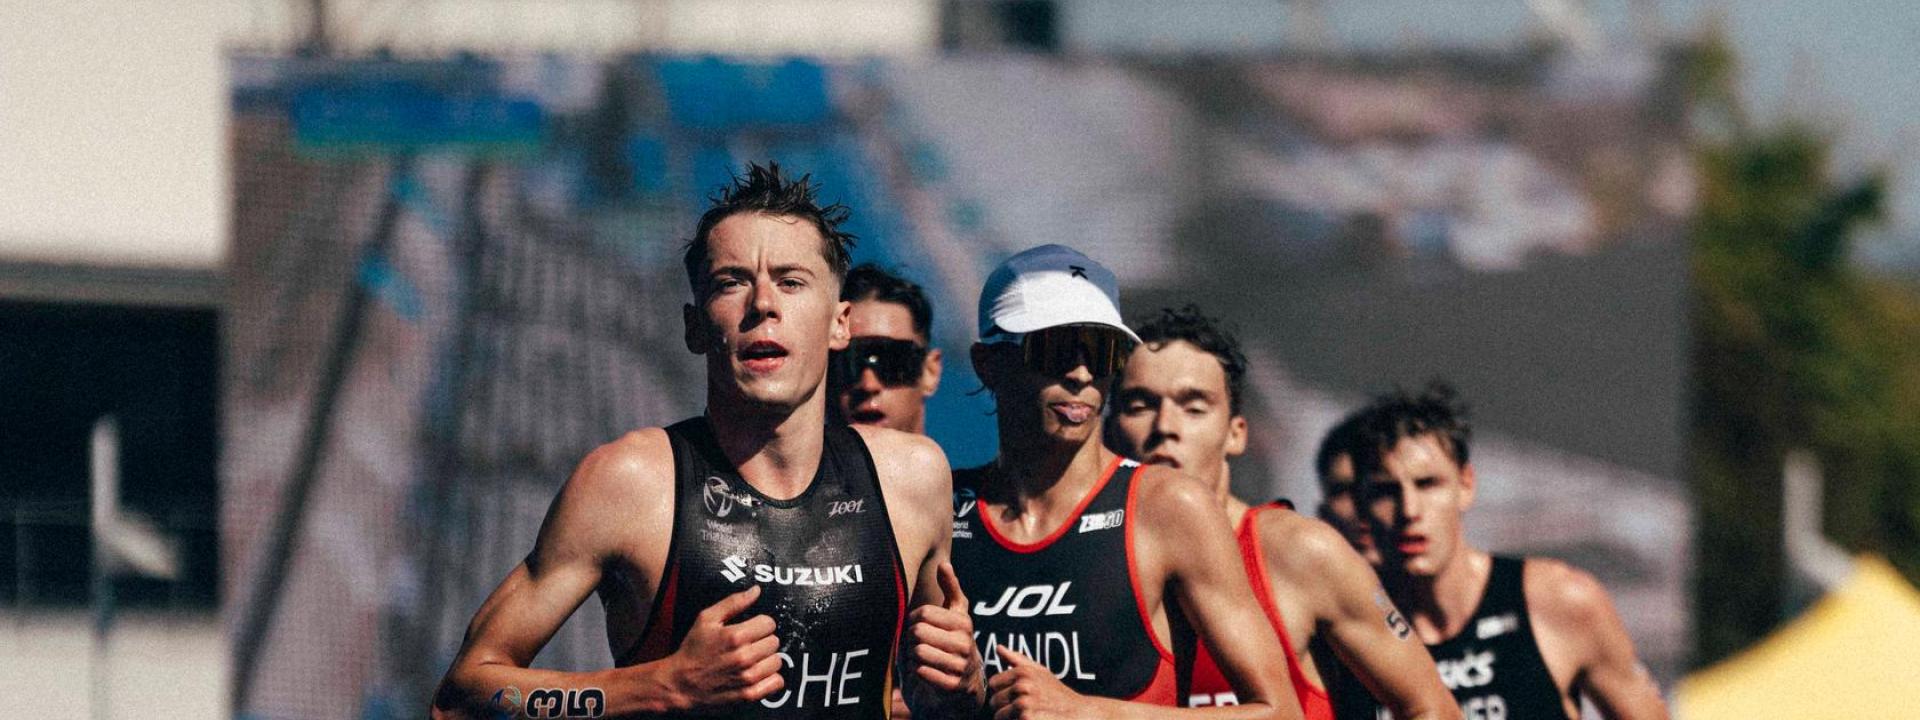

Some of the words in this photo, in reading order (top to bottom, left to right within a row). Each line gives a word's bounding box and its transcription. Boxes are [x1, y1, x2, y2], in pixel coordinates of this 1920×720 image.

[754, 564, 863, 586] SUZUKI
[973, 581, 1077, 618] JOL
[974, 631, 1096, 681] AINDL
[525, 687, 605, 719] 35
